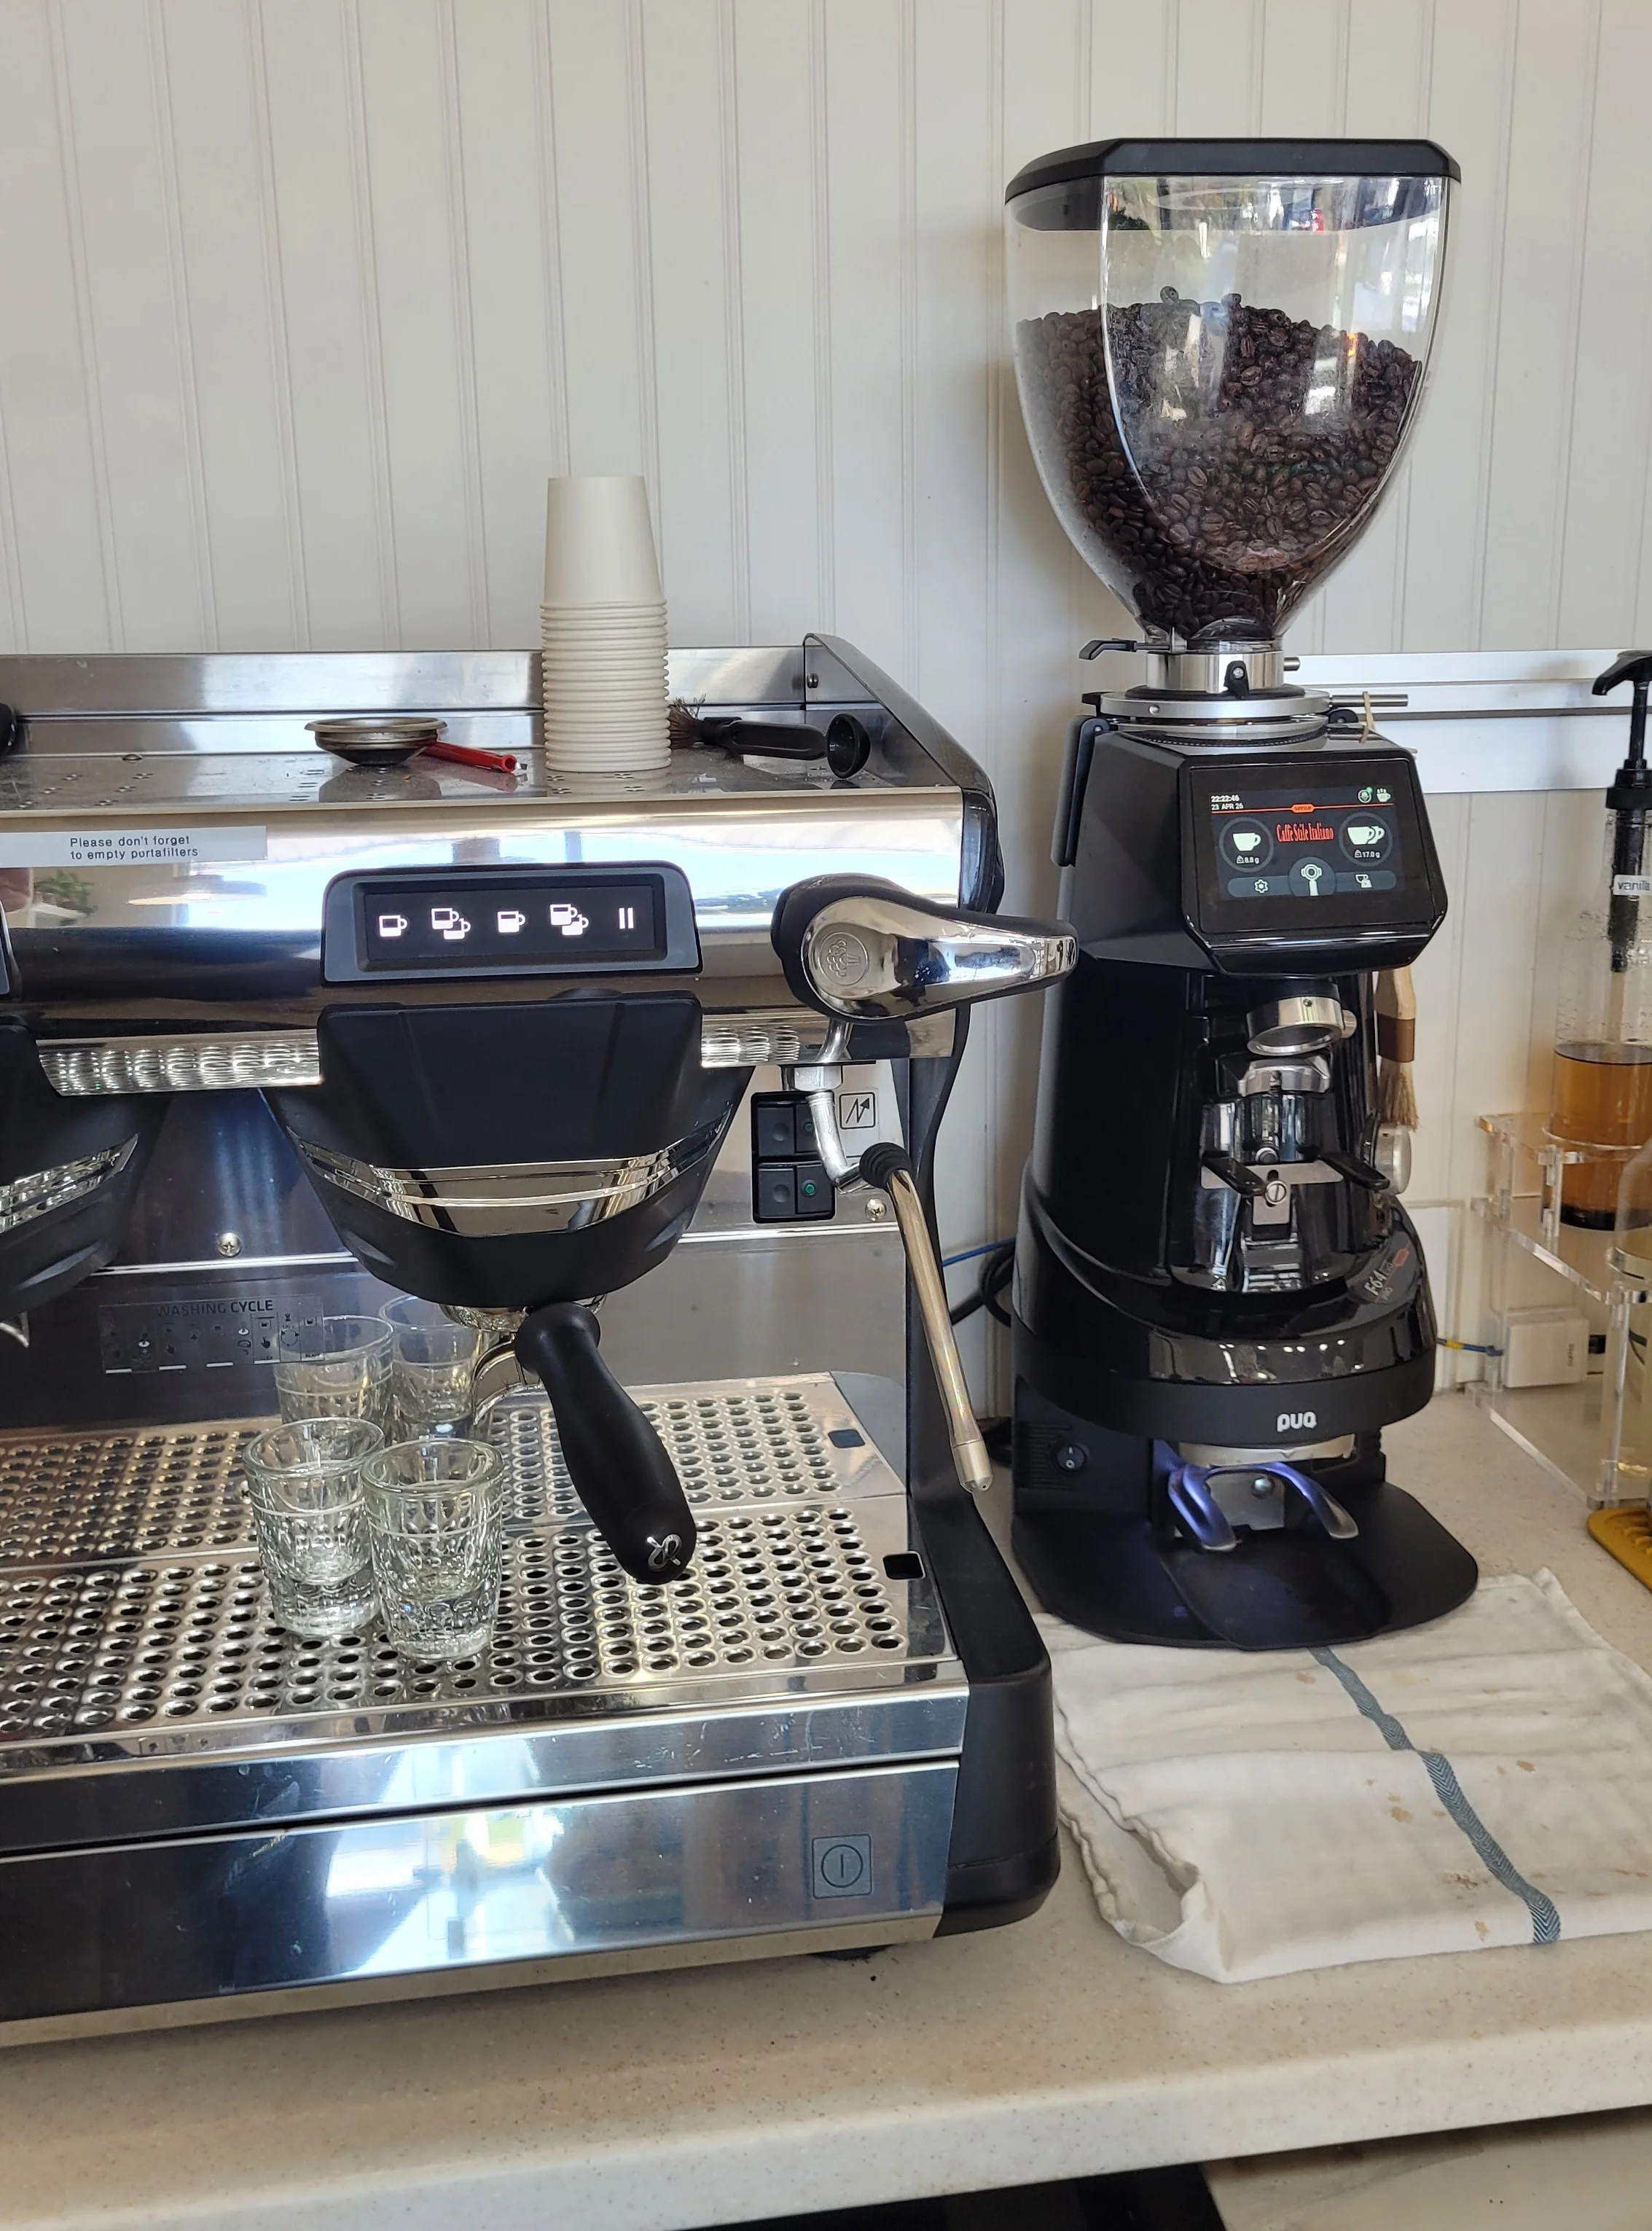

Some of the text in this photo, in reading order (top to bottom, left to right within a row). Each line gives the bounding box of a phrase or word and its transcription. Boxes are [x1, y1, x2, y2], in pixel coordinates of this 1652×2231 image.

[1293, 824, 1309, 841] Stile
[1308, 823, 1334, 840] Italiano
[71, 836, 190, 847] Please don't forget
[71, 848, 198, 860] to empty portafilters
[1364, 1270, 1387, 1296] F64
[157, 1300, 274, 1317] WASHING CYCLE
